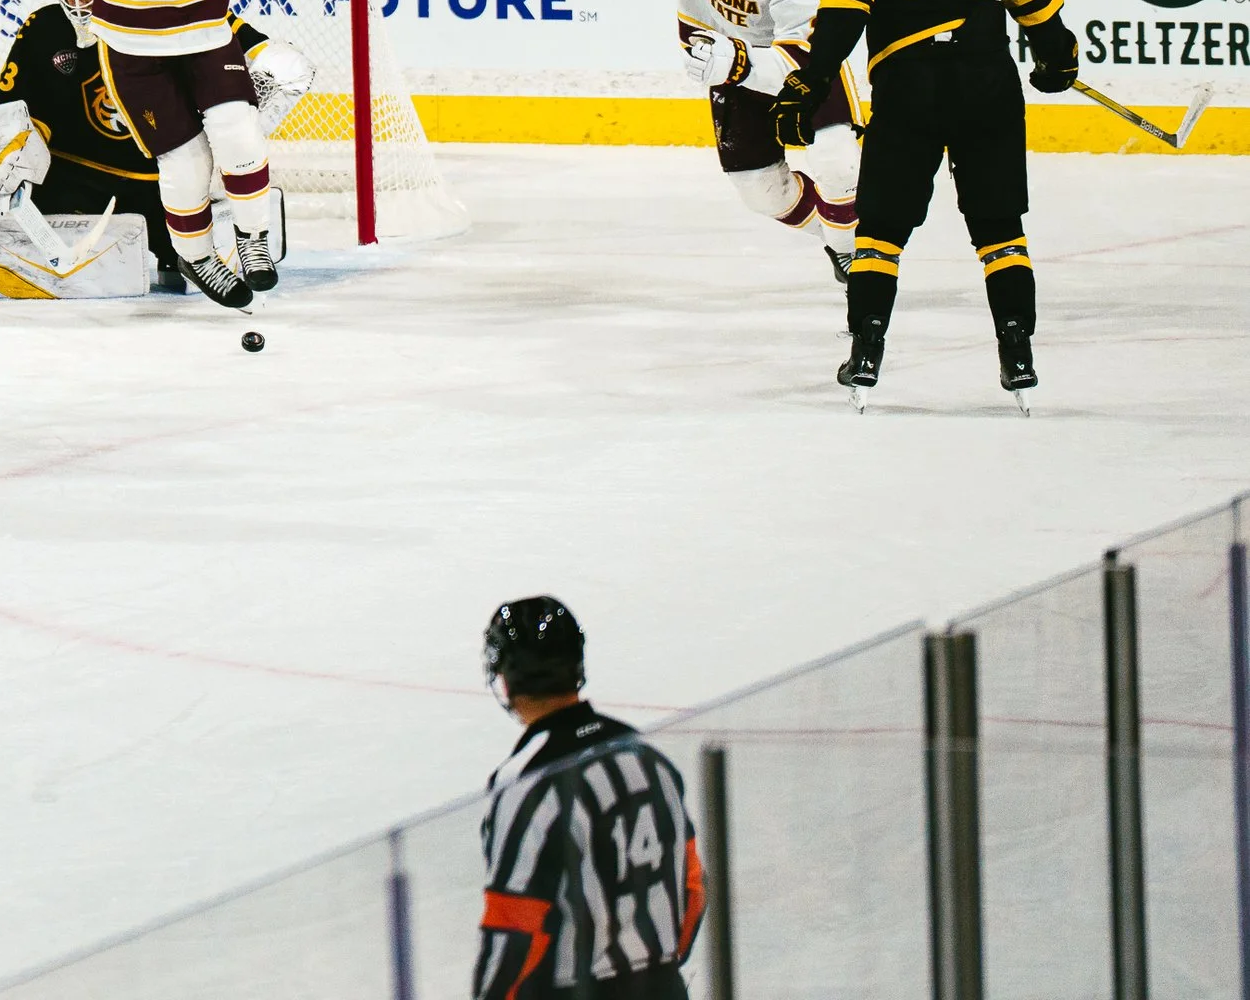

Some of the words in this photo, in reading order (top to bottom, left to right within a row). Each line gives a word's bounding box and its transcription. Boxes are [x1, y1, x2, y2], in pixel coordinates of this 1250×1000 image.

[579, 11, 598, 22] SM
[1085, 19, 1250, 66] SELTZER
[53, 52, 78, 65] NCHC
[47, 220, 90, 229] UER
[611, 802, 664, 884] 14
